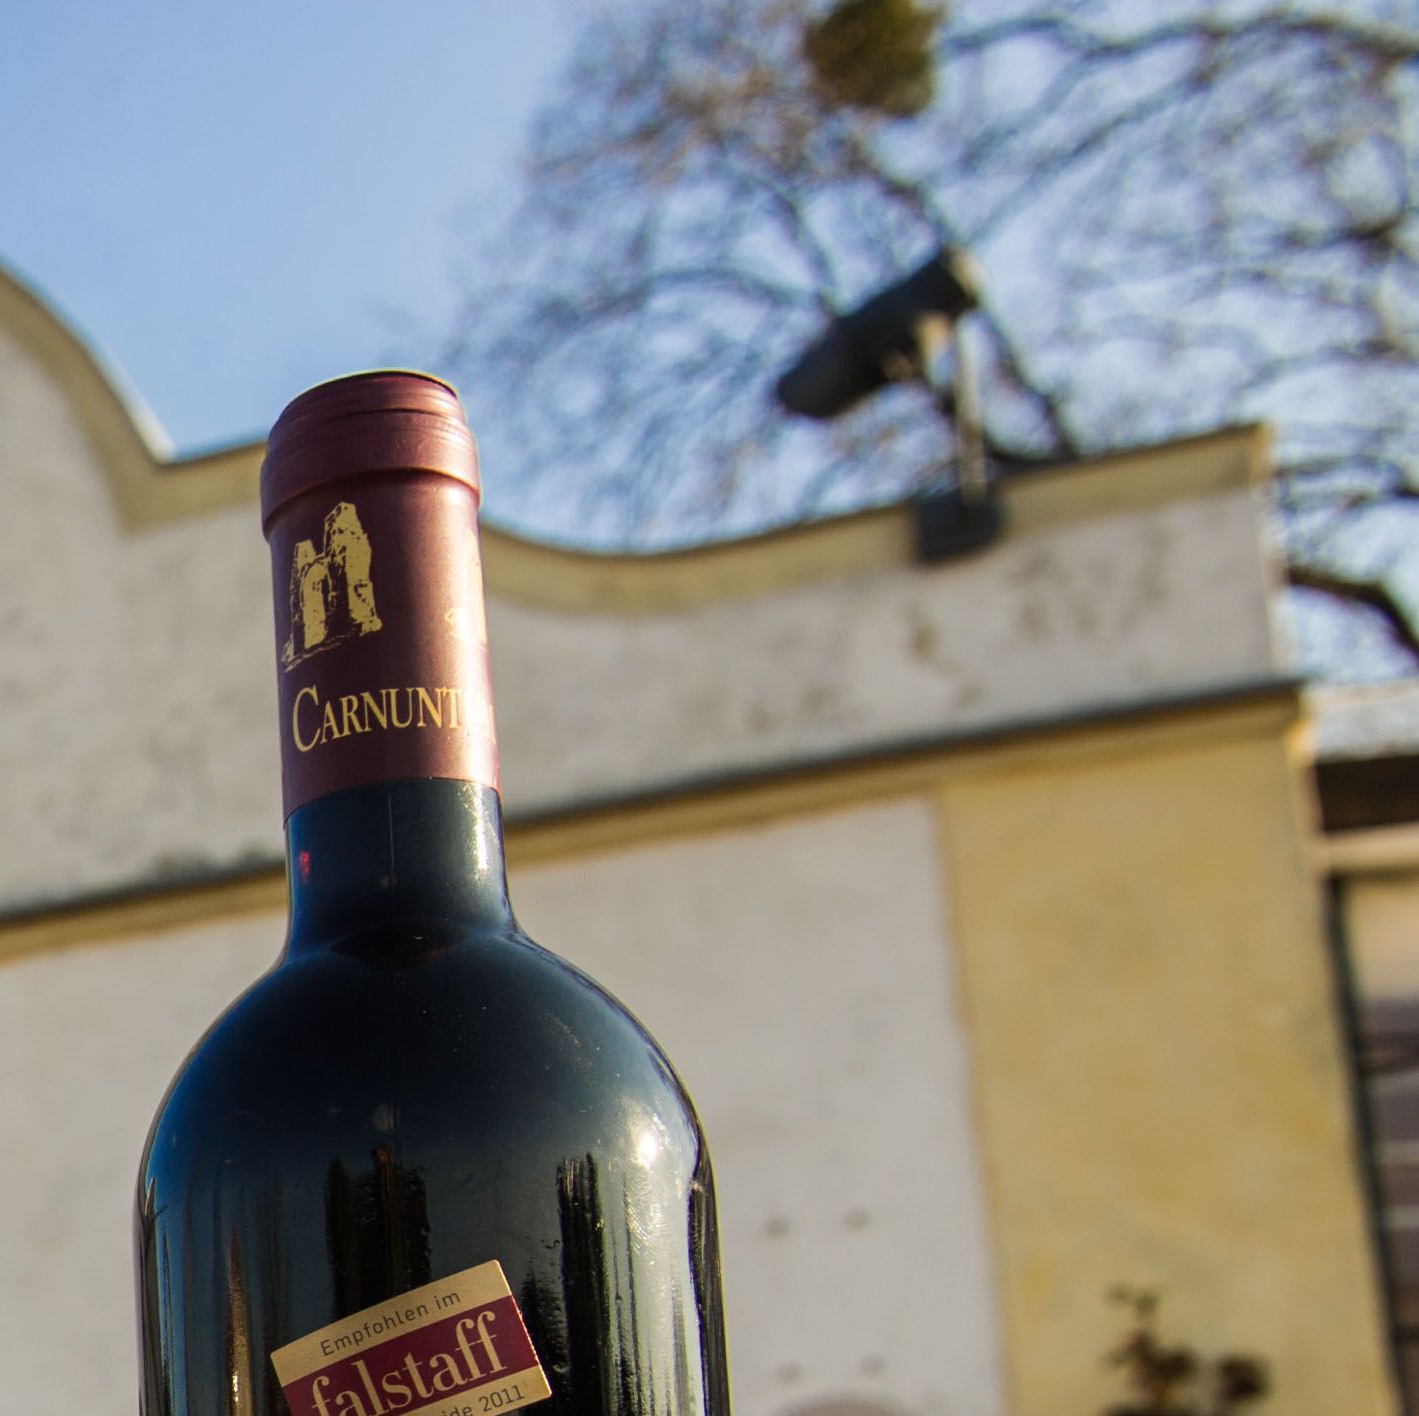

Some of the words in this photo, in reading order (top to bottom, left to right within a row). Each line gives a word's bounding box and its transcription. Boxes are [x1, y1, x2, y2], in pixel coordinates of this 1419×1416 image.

[291, 684, 496, 753] CARNUNT
[319, 1301, 430, 1357] Empfohlen
[434, 1289, 462, 1311] im
[477, 1384, 526, 1413] 2011
